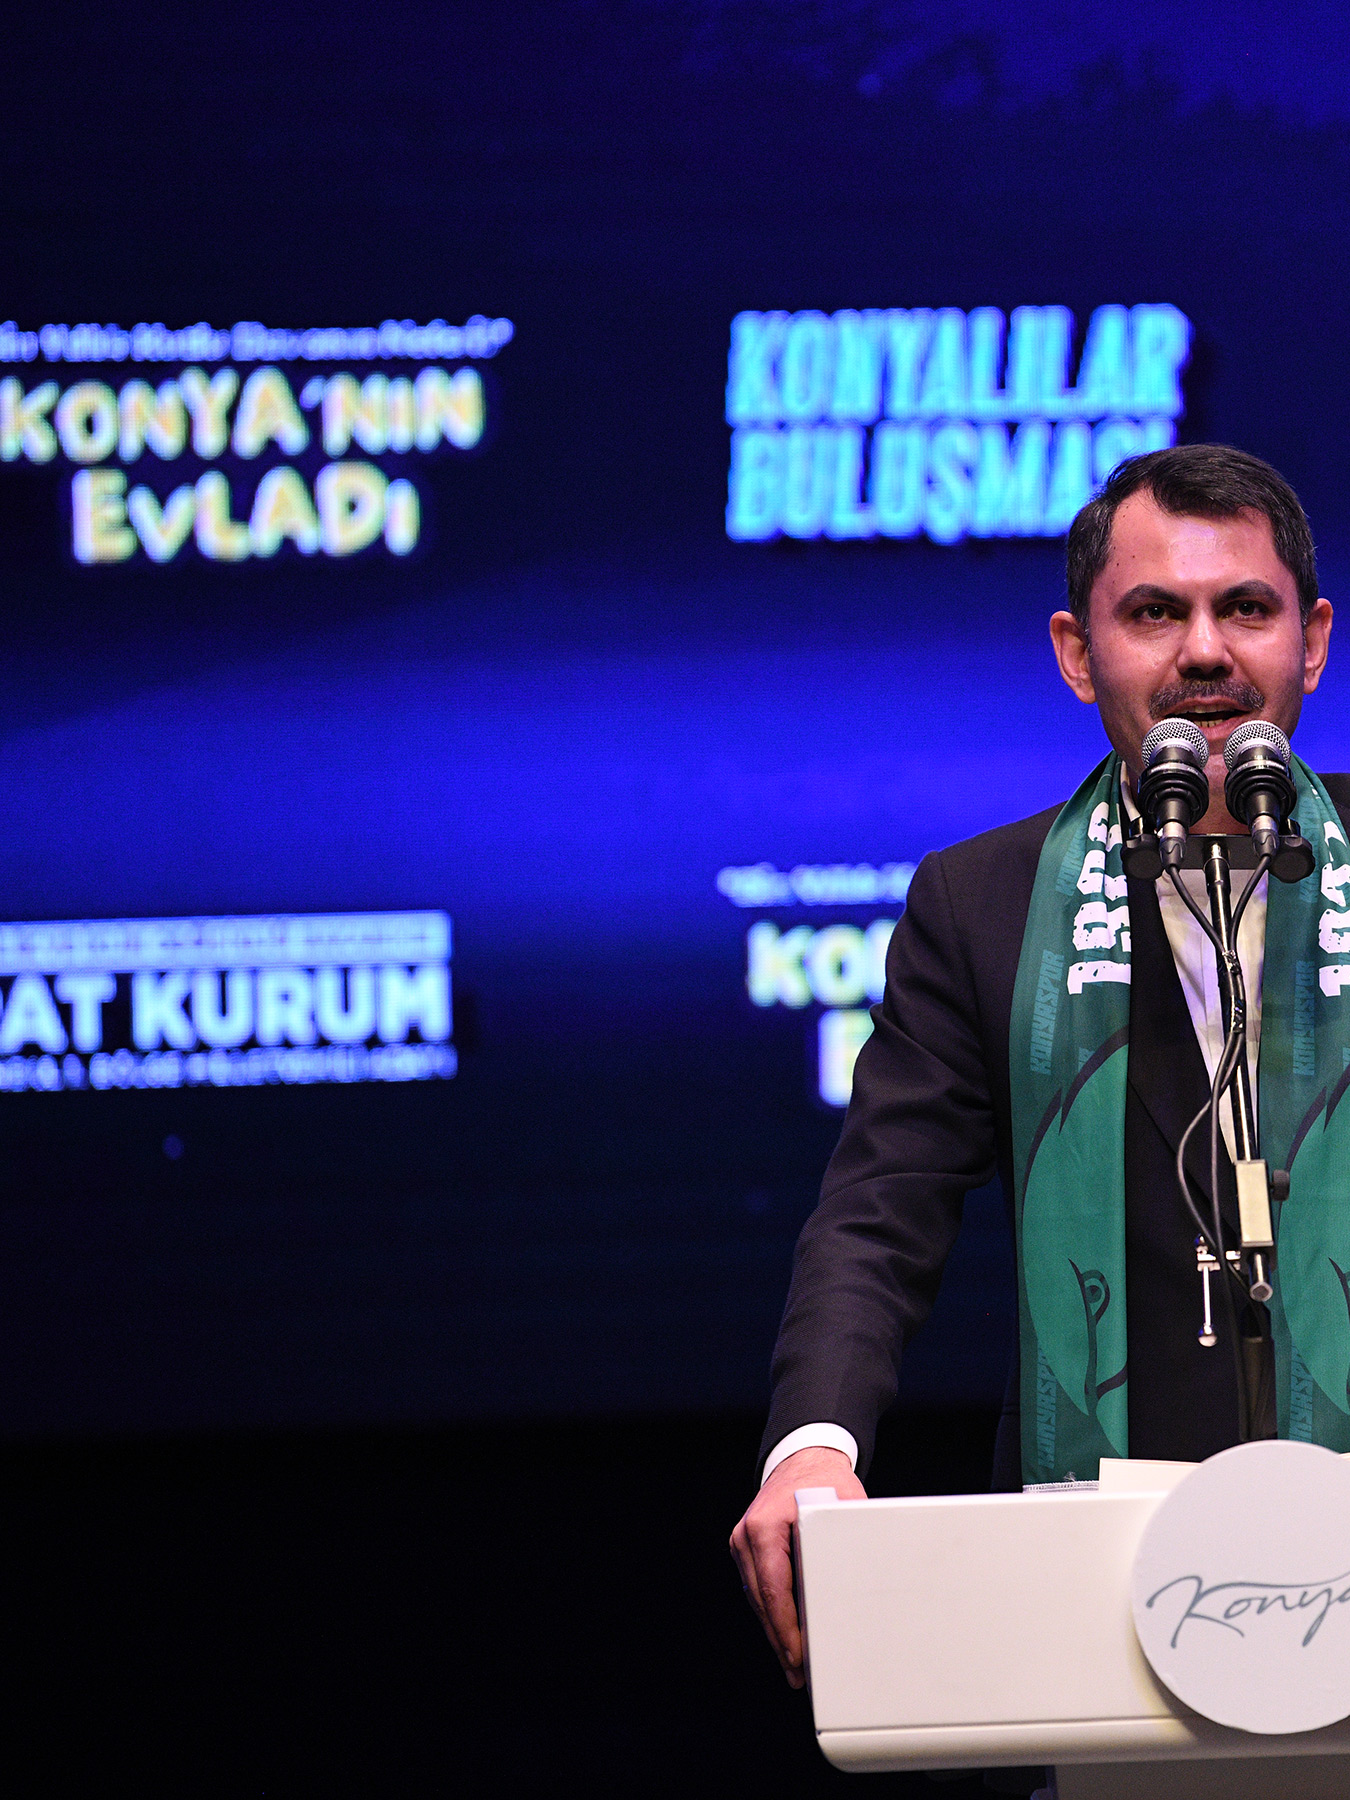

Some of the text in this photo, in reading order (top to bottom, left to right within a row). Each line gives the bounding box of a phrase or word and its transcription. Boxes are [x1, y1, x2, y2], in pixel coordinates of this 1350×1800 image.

[727, 303, 1193, 427] KONYALILAR
[0, 964, 452, 1056] AT KURUM
[1030, 949, 1065, 1076] KONYASPOR
